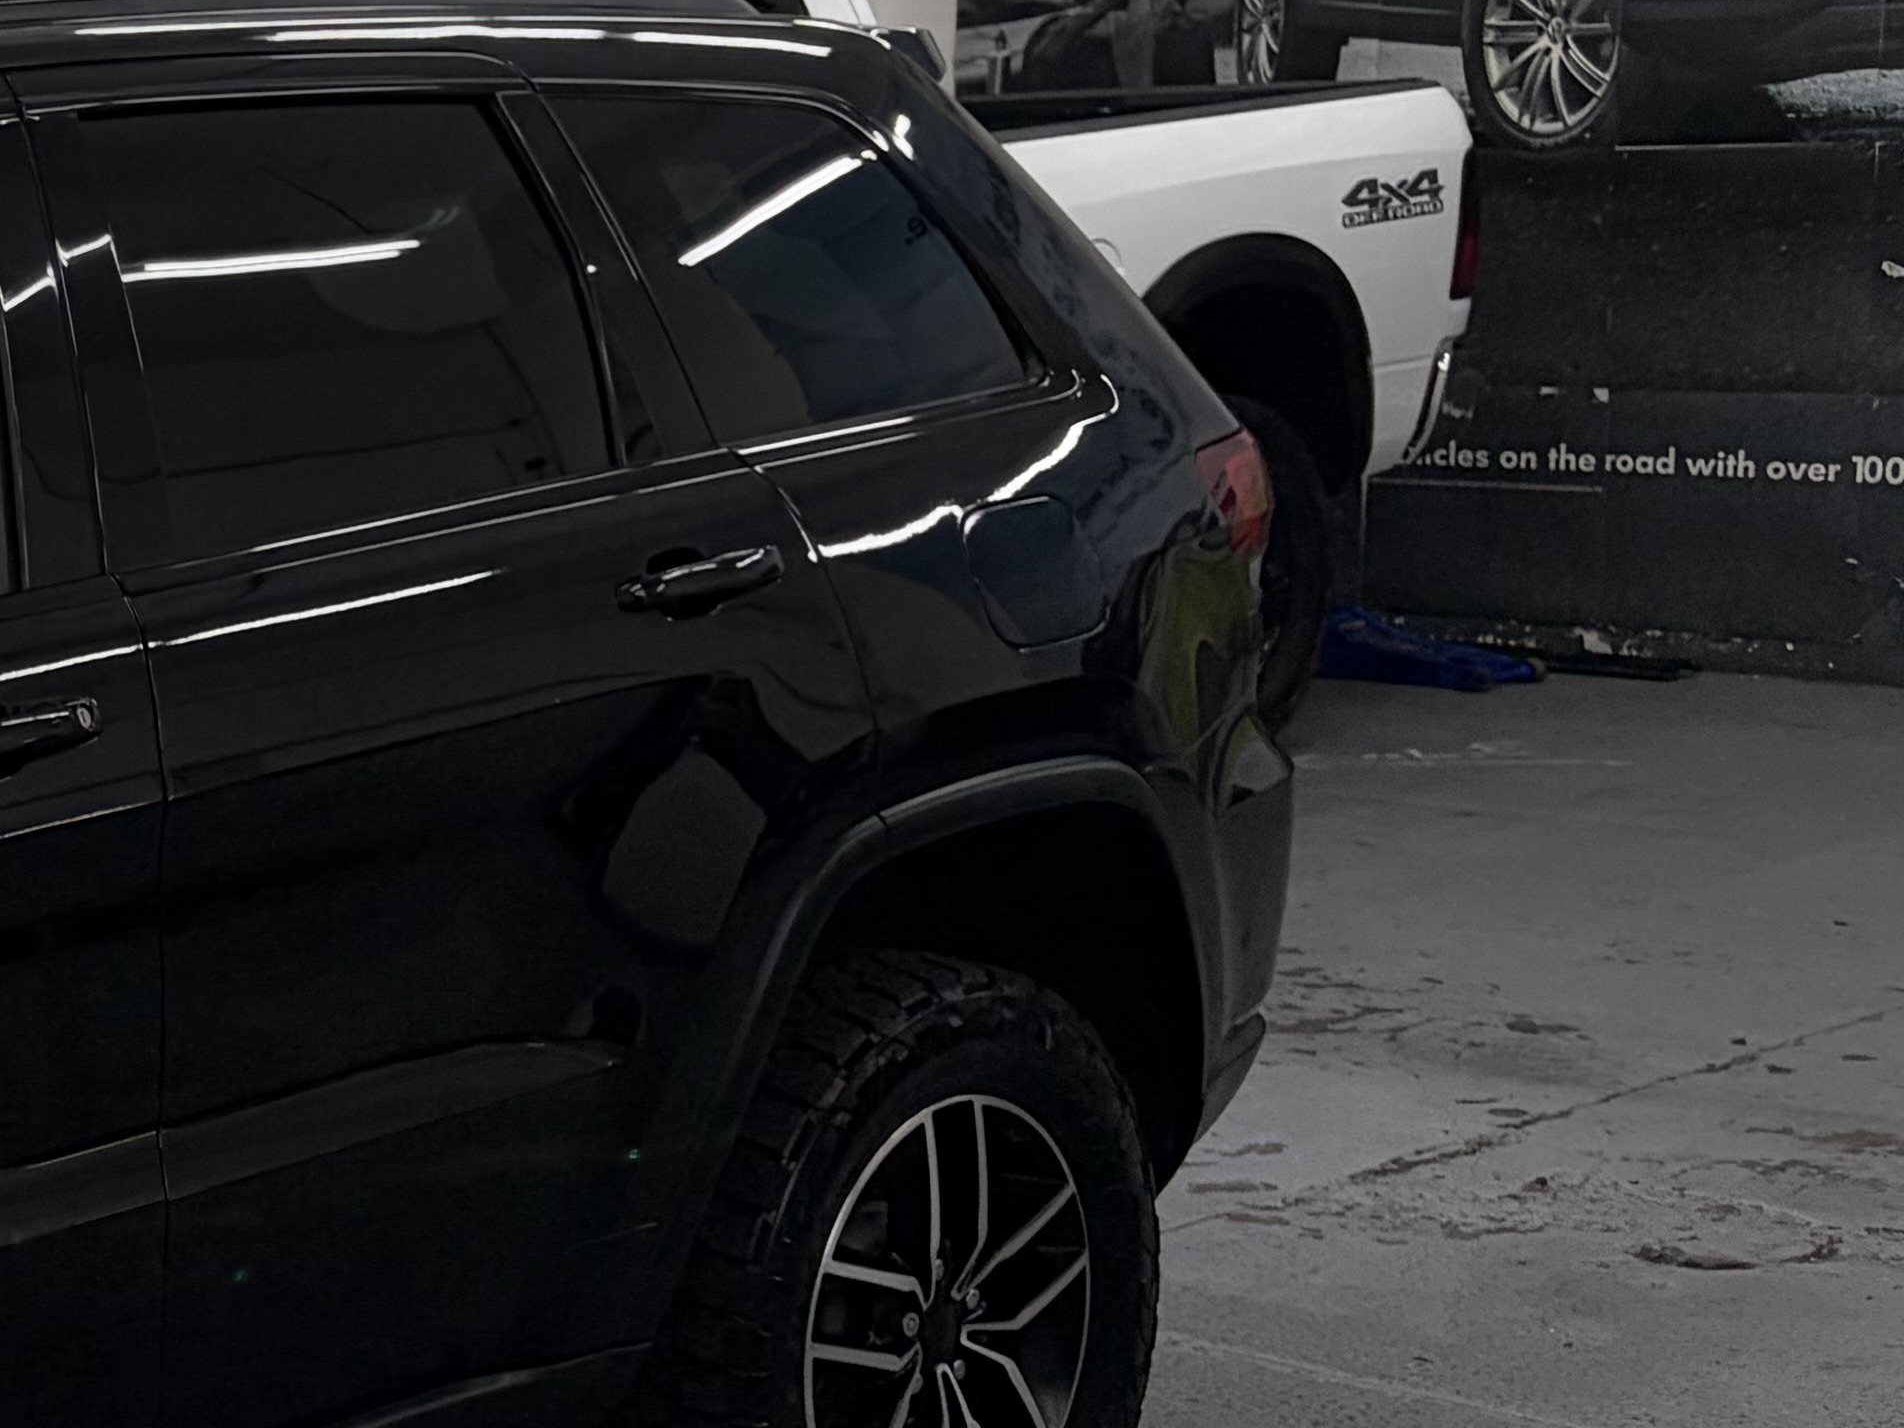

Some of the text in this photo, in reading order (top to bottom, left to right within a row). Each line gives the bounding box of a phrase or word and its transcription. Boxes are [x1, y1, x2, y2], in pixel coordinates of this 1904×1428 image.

[1499, 449, 1538, 470] on
[1548, 442, 1596, 472] the
[1604, 445, 1676, 476] road
[1685, 448, 1756, 479] with
[1765, 460, 1842, 483] over
